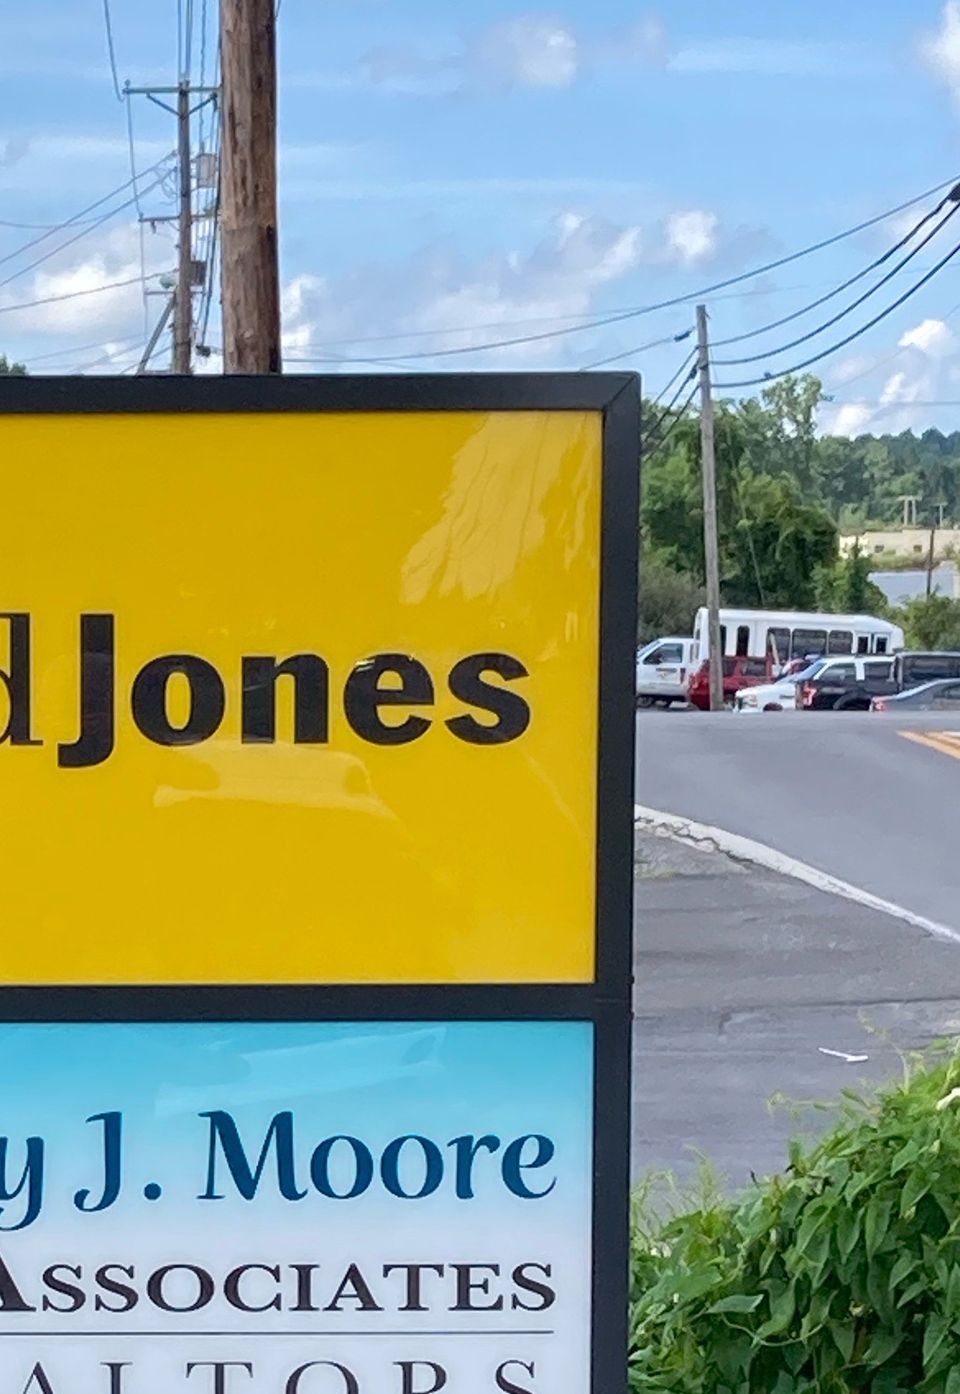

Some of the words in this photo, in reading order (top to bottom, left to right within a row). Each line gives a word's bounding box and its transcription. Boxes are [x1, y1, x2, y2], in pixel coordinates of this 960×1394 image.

[57, 613, 531, 769] Jones
[73, 1110, 163, 1213] J.
[196, 1109, 558, 1201] Moore
